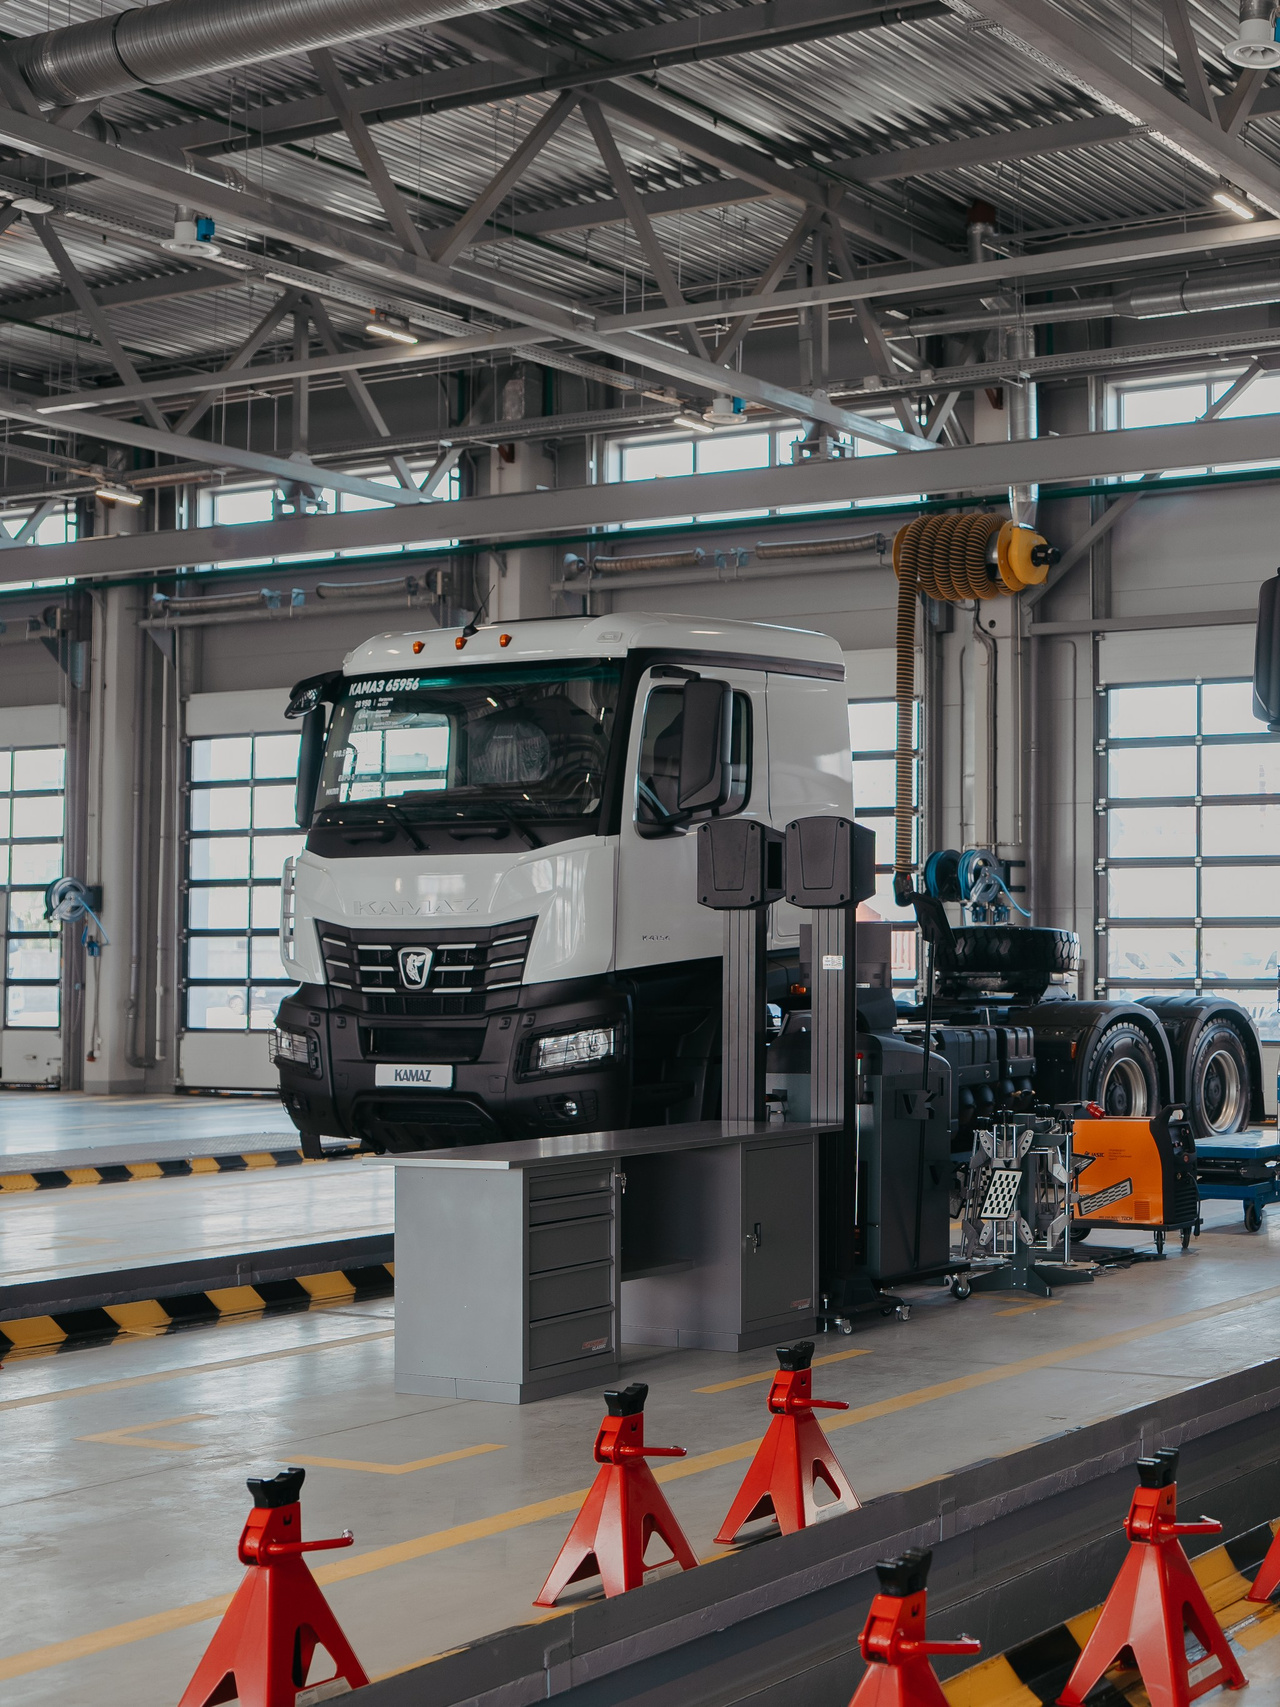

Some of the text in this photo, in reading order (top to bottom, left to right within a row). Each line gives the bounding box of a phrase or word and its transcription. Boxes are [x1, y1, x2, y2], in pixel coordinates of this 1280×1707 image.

[349, 678, 420, 696] КАМАЗ 65956
[354, 898, 479, 915] KAMAZ
[394, 1069, 432, 1082] KAMAZ
